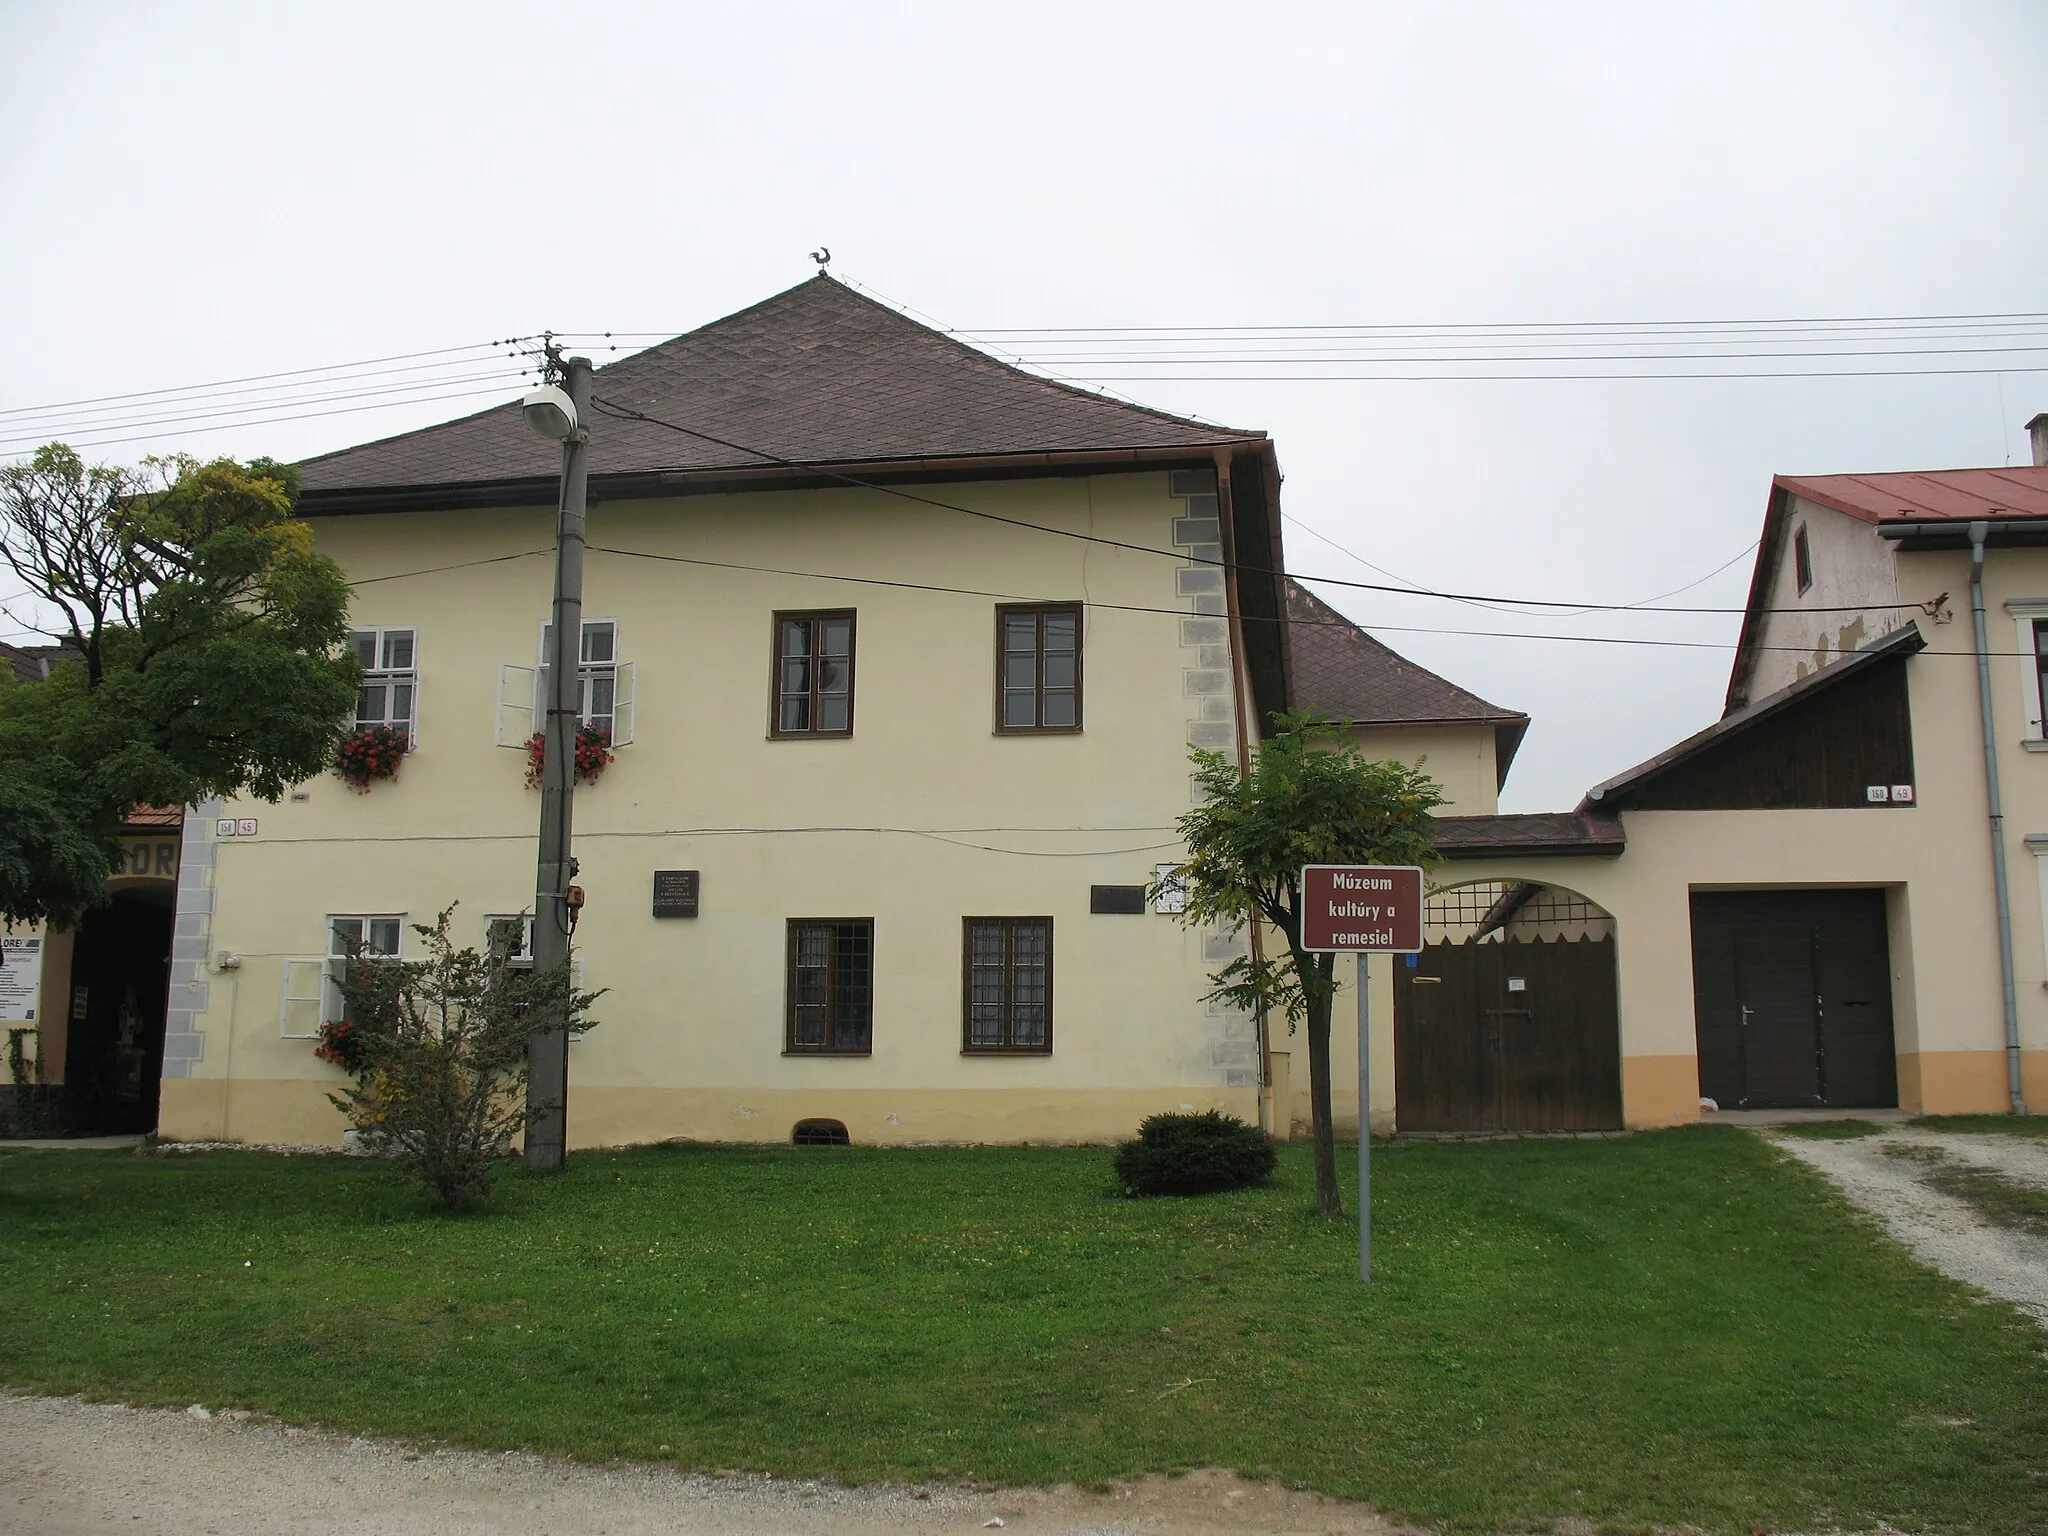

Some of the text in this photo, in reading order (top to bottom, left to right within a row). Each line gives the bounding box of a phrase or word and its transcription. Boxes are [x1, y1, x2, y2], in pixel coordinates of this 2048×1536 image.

[1896, 788, 1908, 799] 49
[242, 822, 252, 832] 45
[111, 843, 175, 876] OR
[1333, 873, 1392, 890] Múzeum
[1329, 900, 1395, 921] kultúry a
[1332, 928, 1393, 945] remesiel
